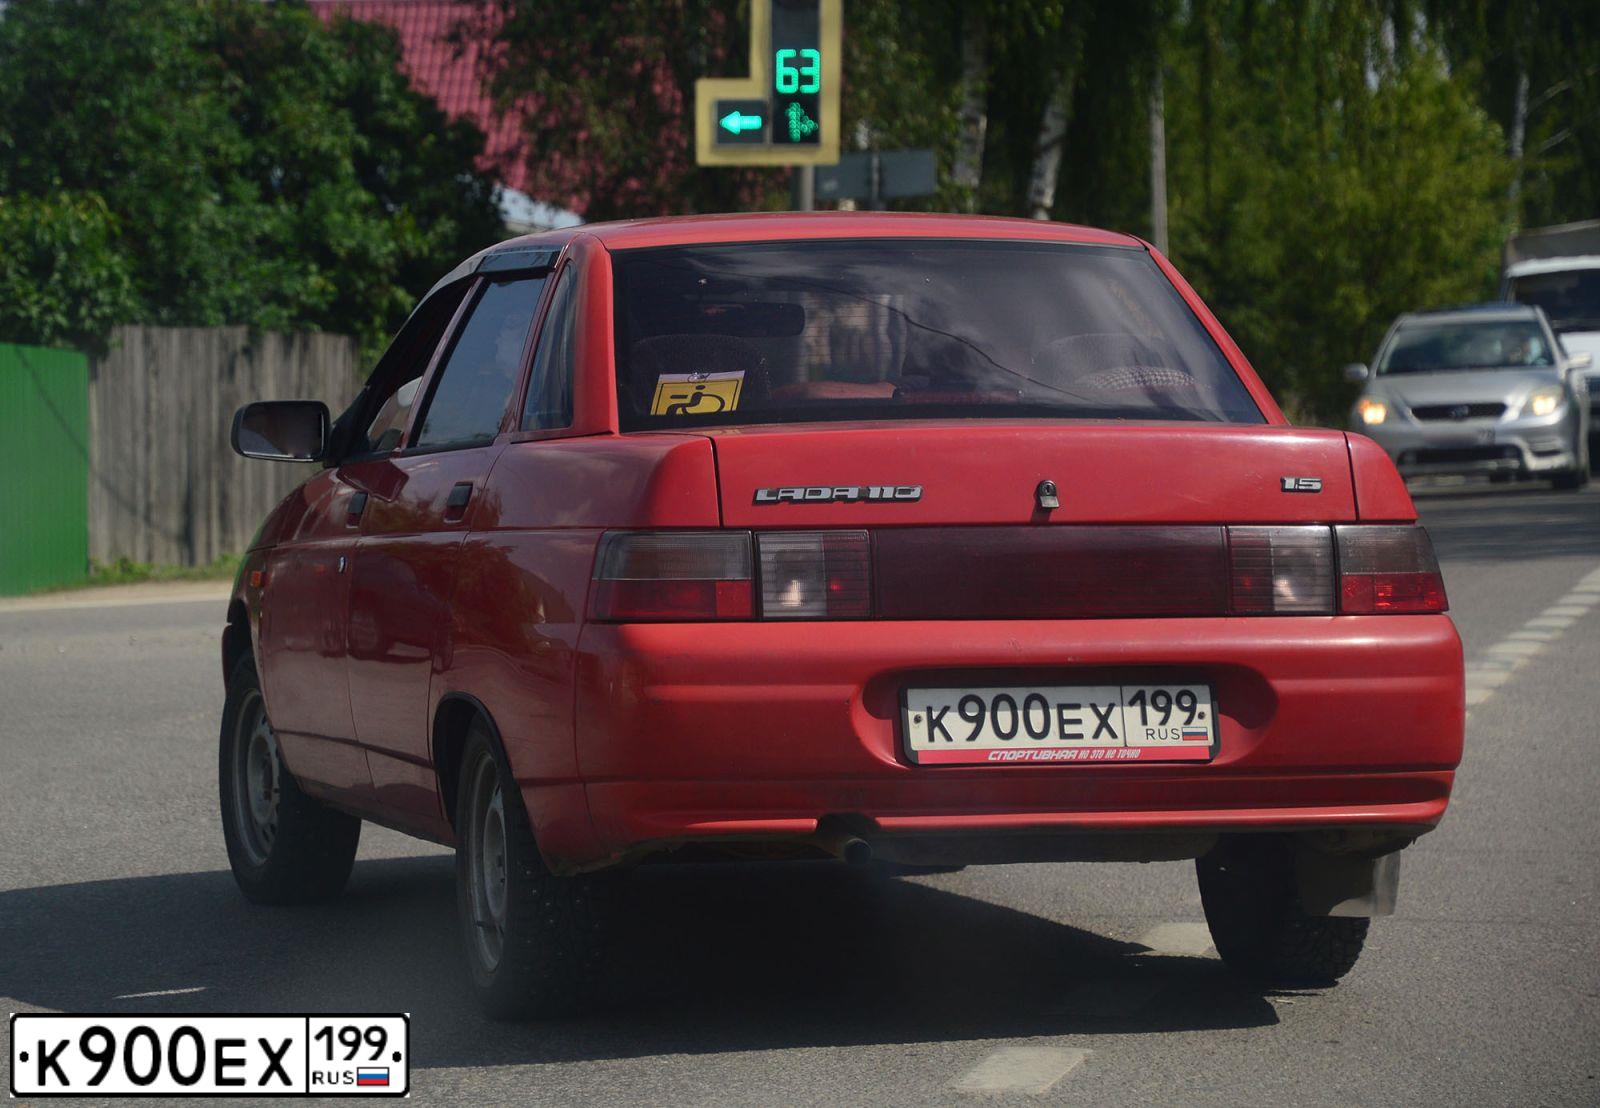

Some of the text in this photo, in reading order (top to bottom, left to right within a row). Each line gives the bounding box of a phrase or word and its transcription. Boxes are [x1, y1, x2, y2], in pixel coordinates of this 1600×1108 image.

[775, 48, 821, 94] 63
[754, 485, 923, 502] LADA 110
[926, 689, 1199, 743] К900ЕХ 199
[1145, 727, 1181, 741] RUS
[987, 748, 1078, 761] СПОРТИВНАЯ
